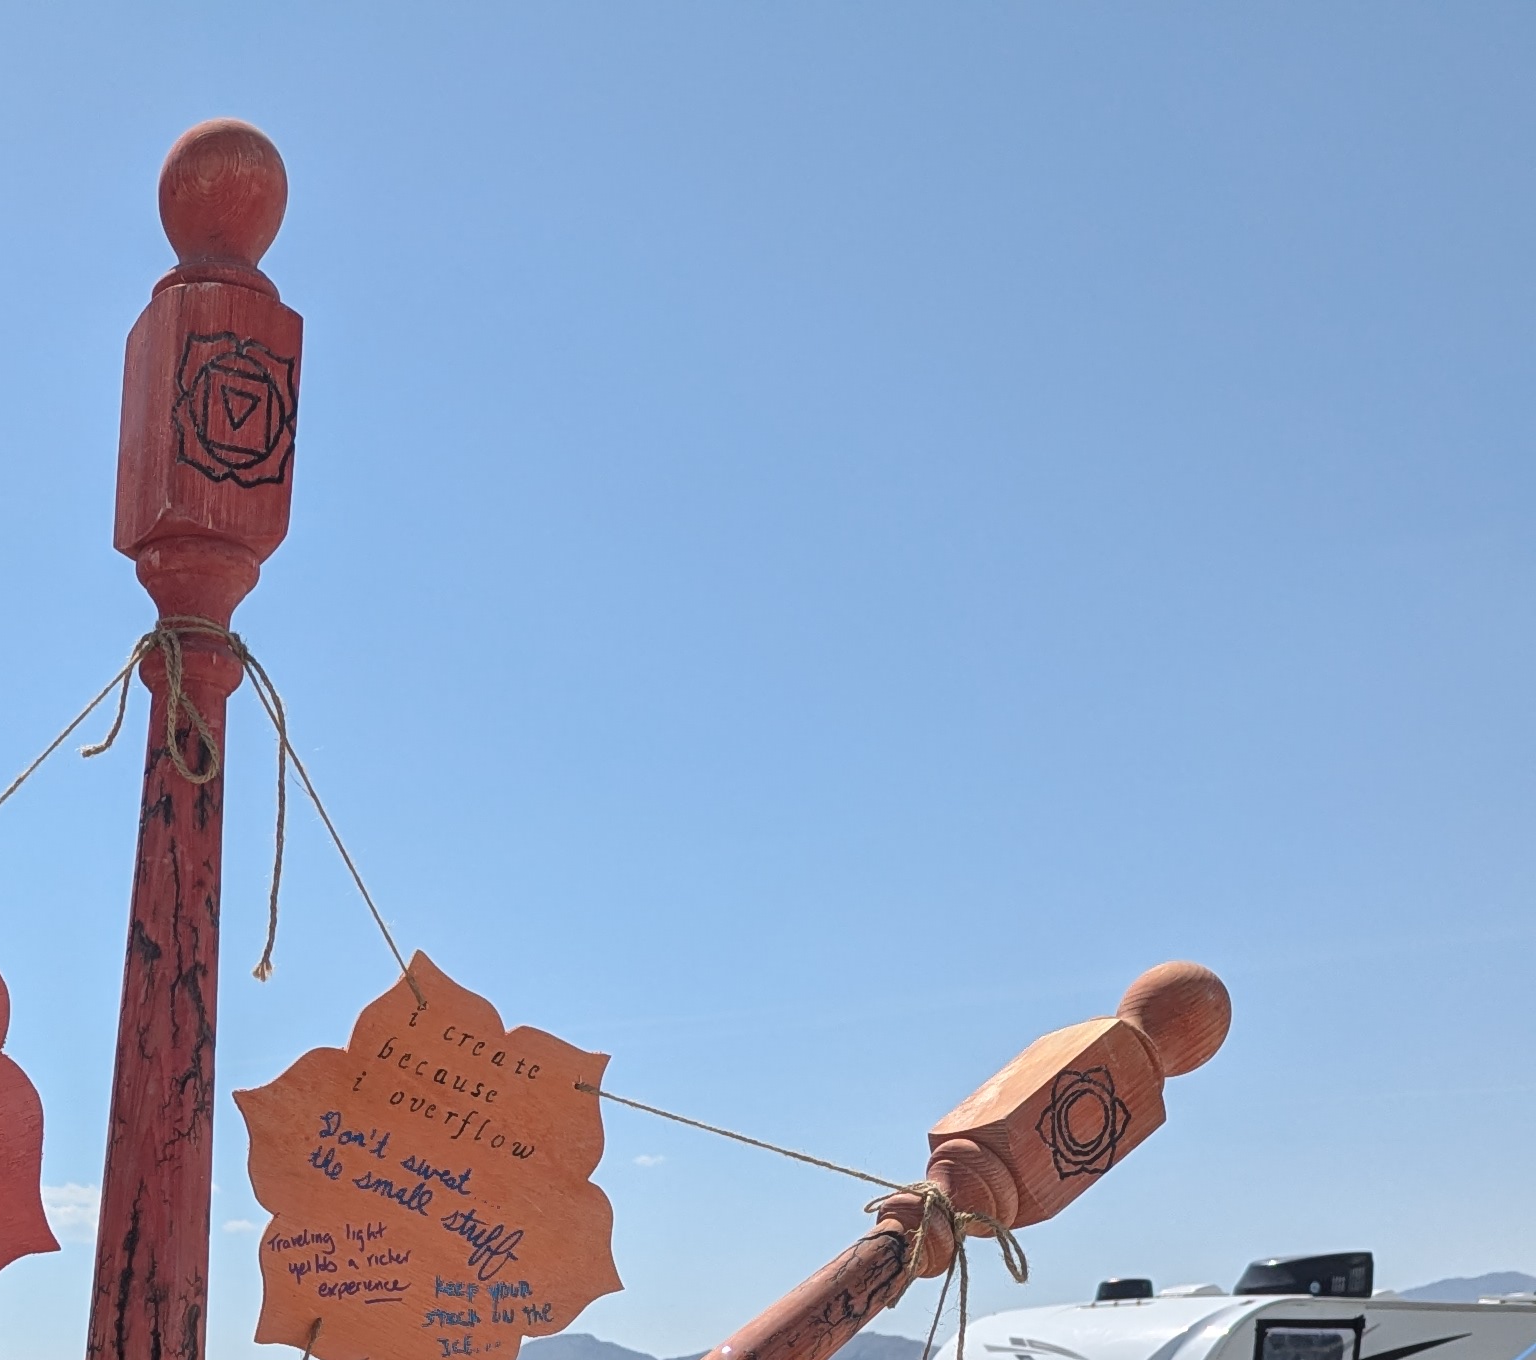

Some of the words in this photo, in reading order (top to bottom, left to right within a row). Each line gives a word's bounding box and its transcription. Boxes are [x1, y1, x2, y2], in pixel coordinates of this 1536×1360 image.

[377, 1037, 497, 1103] because
[408, 1010, 418, 1028] i
[443, 1025, 541, 1080] create
[320, 1112, 389, 1160] Don't
[353, 1071, 366, 1091] i
[389, 1090, 535, 1159] overflow
[308, 1152, 340, 1179] the
[353, 1171, 429, 1216] small
[441, 1209, 524, 1281] stuff
[346, 1221, 387, 1250] light
[348, 1256, 359, 1268] a
[367, 1250, 410, 1267] richer
[318, 1277, 411, 1300] experience
